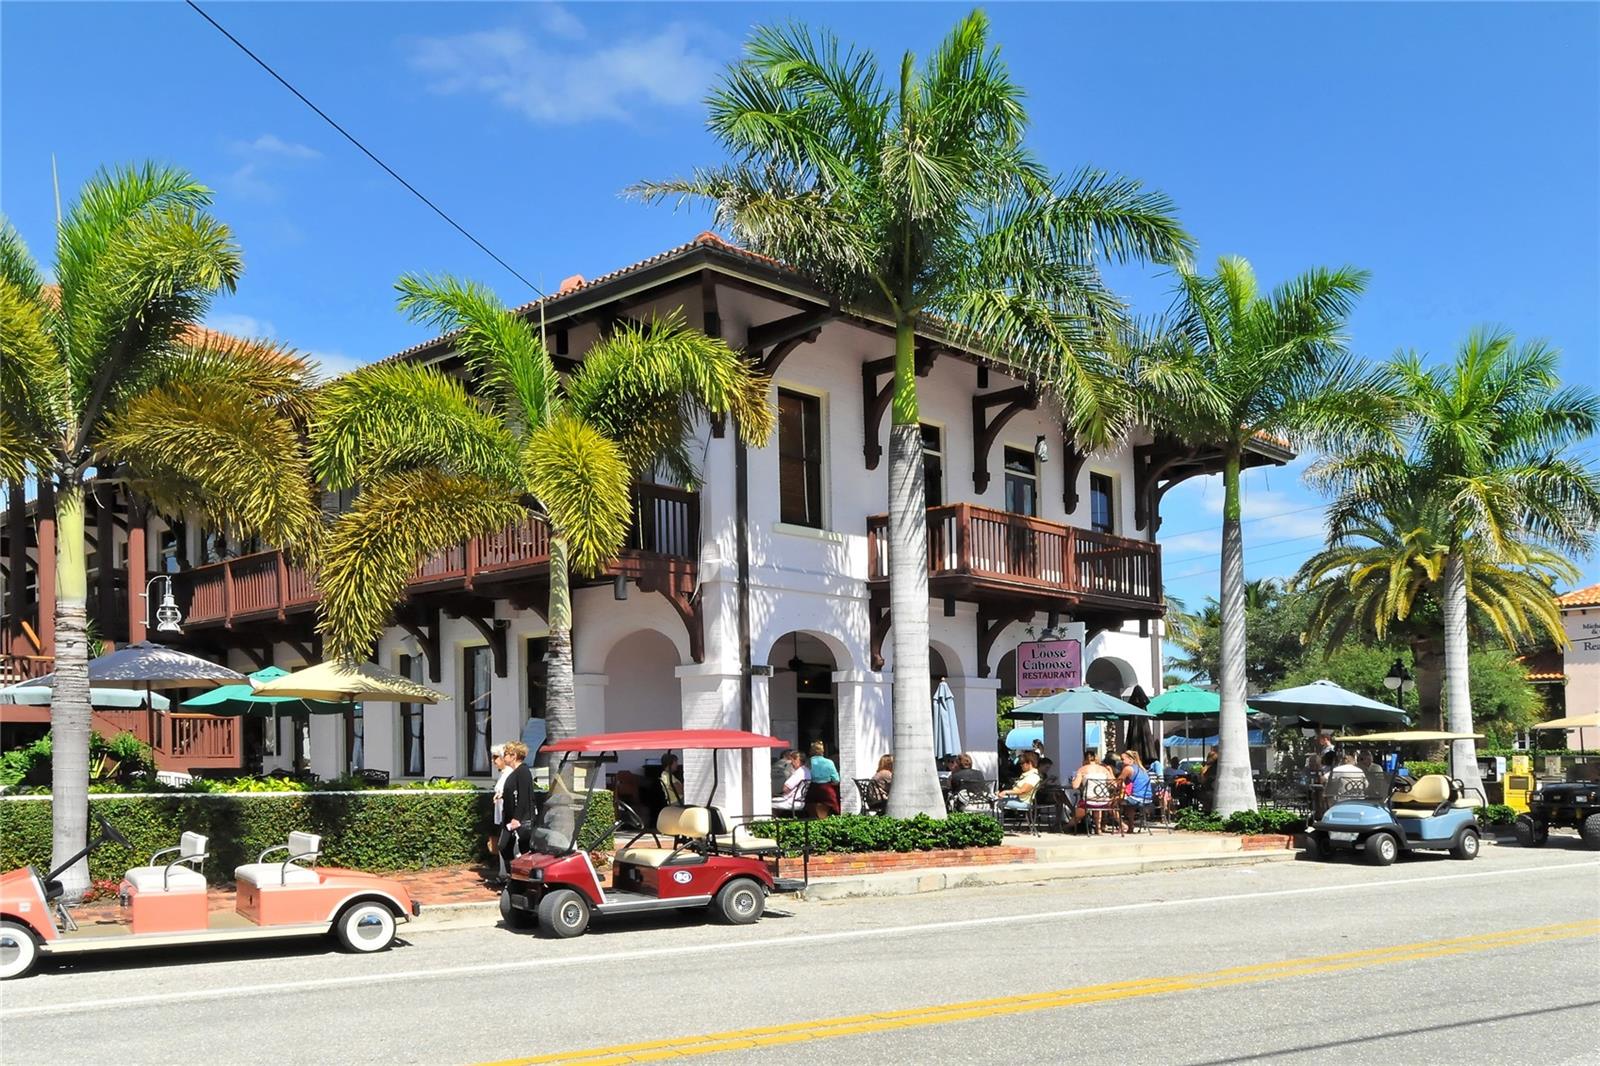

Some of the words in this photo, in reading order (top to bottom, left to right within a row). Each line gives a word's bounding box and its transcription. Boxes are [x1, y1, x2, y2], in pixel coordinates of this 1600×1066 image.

[1032, 649, 1067, 659] Loose
[1022, 660, 1073, 671] Caboose
[1022, 671, 1077, 680] RESTAURANT
